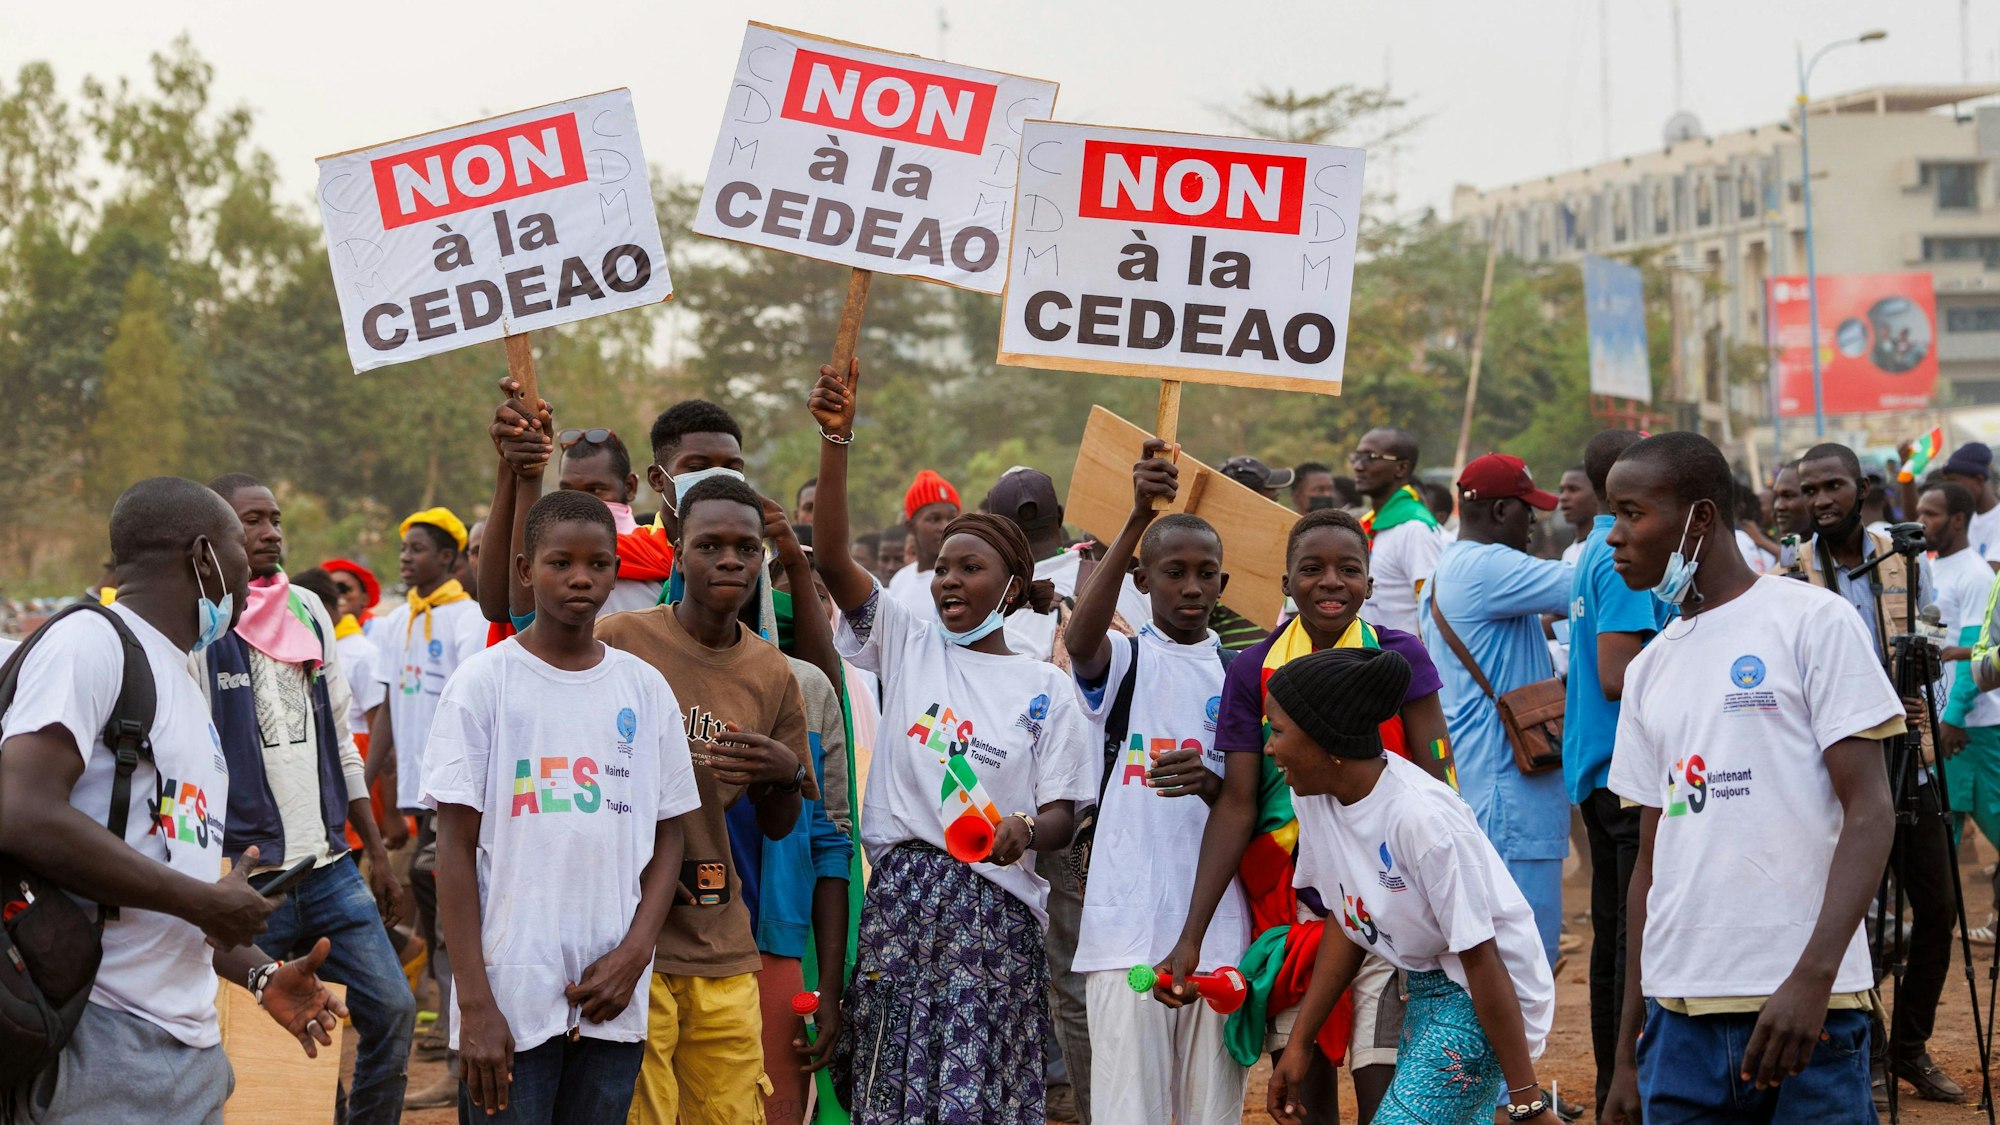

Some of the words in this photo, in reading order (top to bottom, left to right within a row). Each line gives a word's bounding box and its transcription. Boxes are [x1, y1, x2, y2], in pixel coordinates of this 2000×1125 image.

[802, 62, 975, 142] NON
[392, 127, 566, 216] NON
[808, 134, 850, 186] à
[871, 145, 933, 201] la
[1100, 153, 1284, 222] NON
[432, 223, 474, 272] à
[492, 209, 560, 257] la
[715, 180, 1000, 273] CEDEAO
[1117, 229, 1159, 283] à
[1187, 235, 1252, 291] la
[361, 243, 653, 352] CEDEAO
[1023, 290, 1337, 365] CEDEAO
[907, 702, 974, 758] AES
[969, 737, 1008, 760] Maintenant
[970, 749, 1001, 769] Toujours
[1207, 749, 1226, 764] Main
[511, 756, 602, 818] AES
[1707, 768, 1752, 785] Maintenant
[1710, 786, 1750, 800] Toujours
[148, 778, 208, 849] AES
